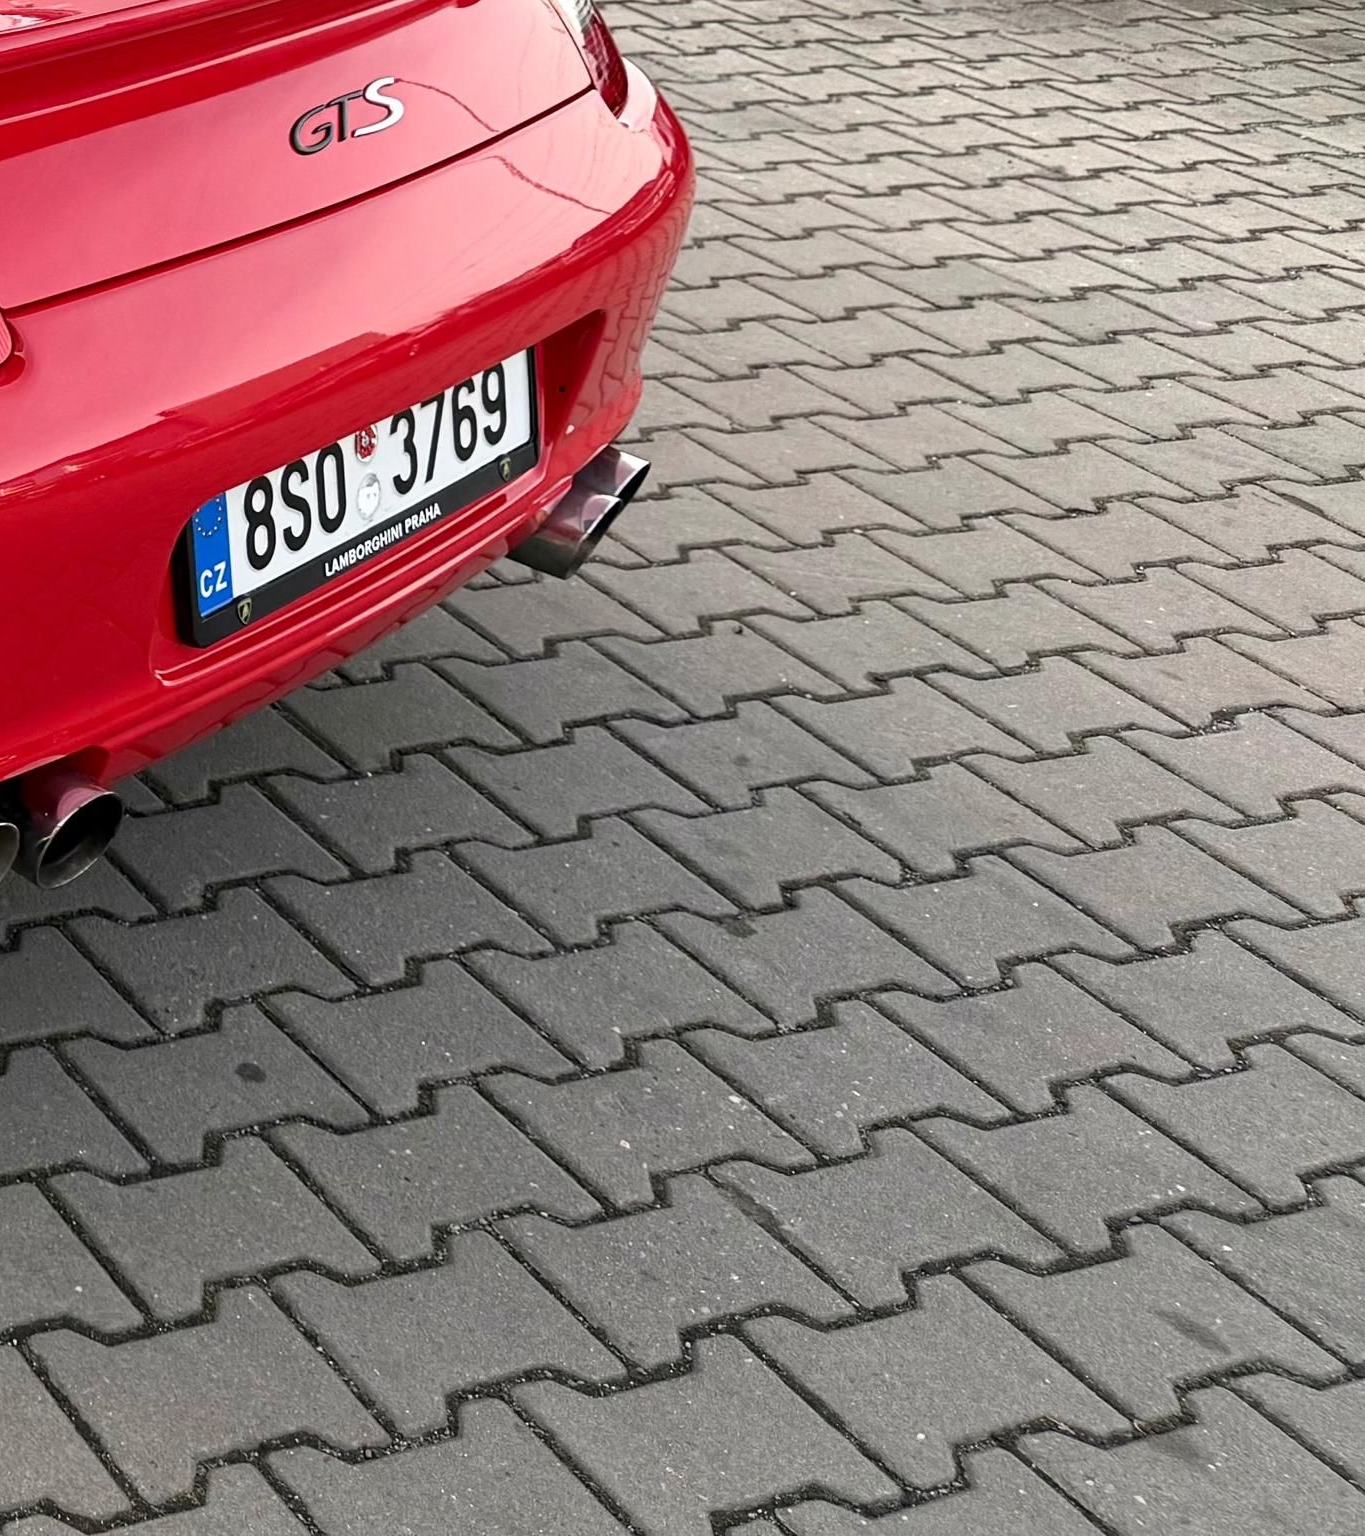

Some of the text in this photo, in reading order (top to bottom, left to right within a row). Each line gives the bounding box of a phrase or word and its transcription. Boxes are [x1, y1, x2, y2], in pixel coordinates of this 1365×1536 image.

[289, 76, 405, 156] GTS
[200, 562, 228, 599] CZ
[389, 362, 507, 496] 3769
[324, 502, 442, 577] LAMBORGHINI PRAHA
